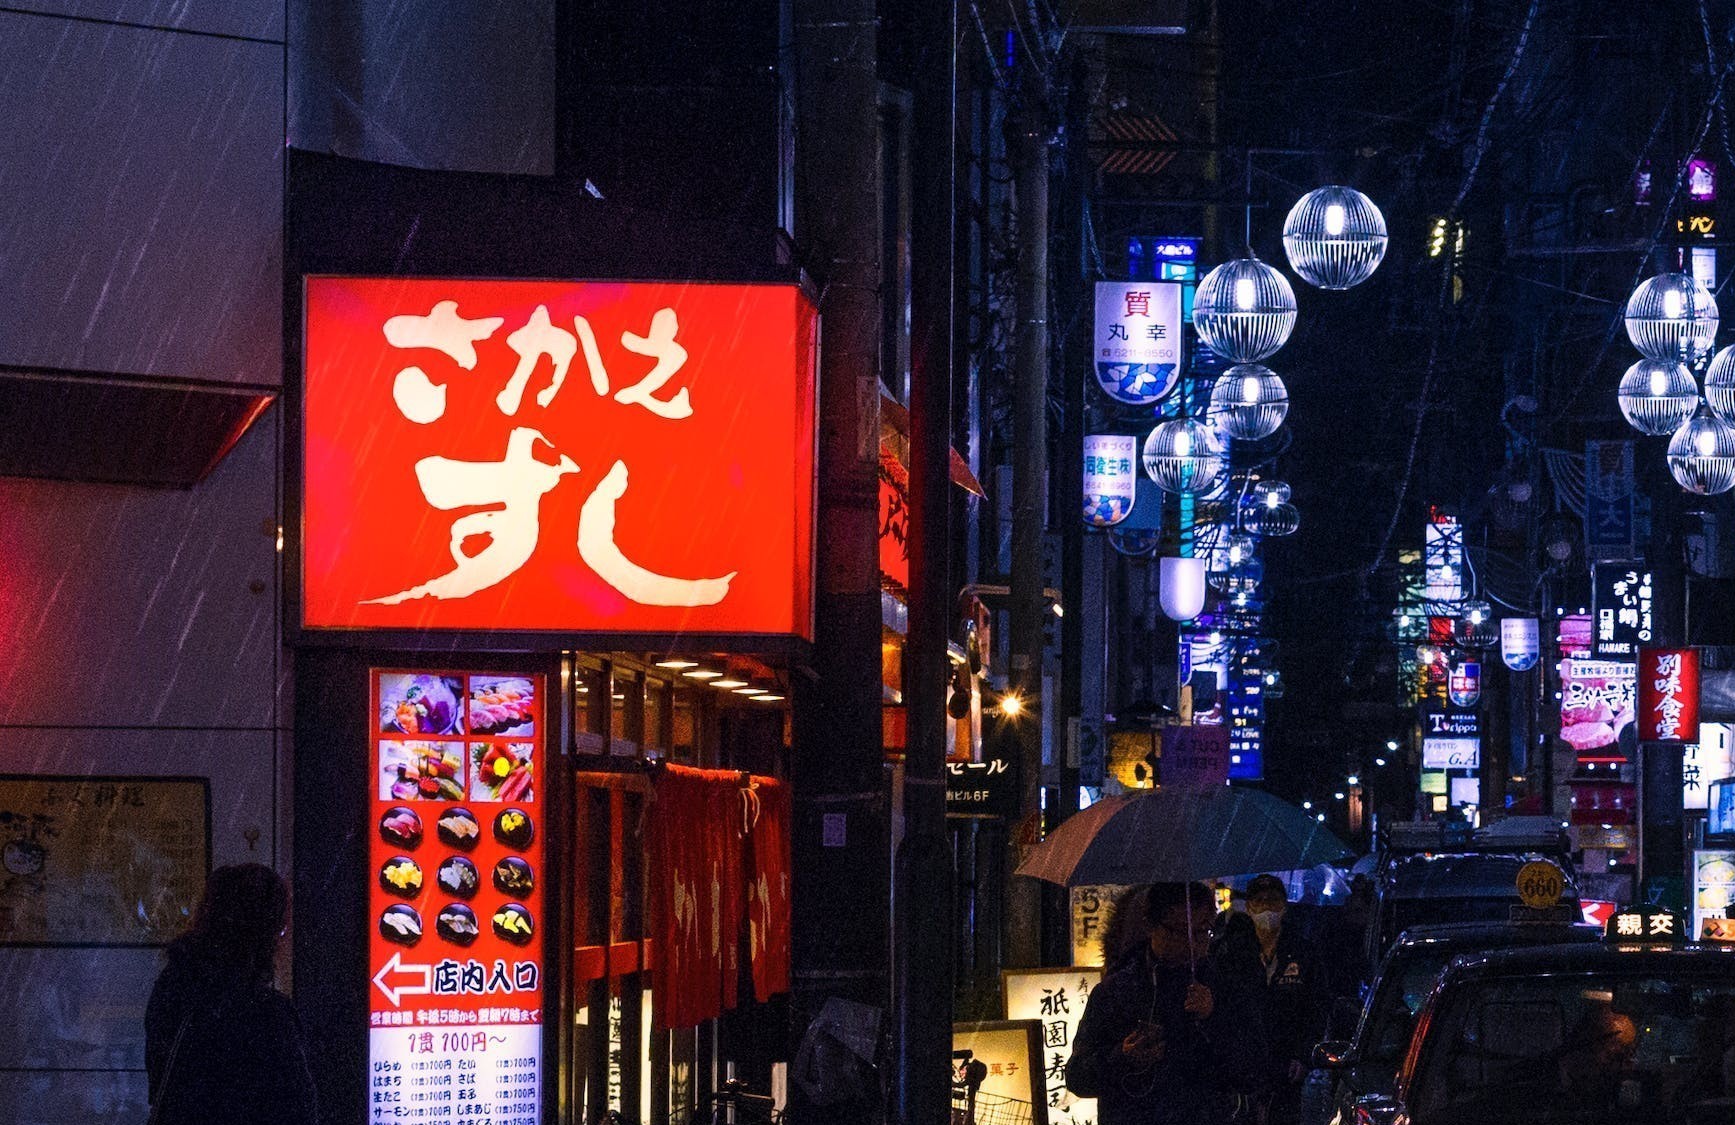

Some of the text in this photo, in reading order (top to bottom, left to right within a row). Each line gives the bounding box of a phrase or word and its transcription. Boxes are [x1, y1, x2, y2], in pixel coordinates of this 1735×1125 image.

[1124, 291, 1151, 317] 質
[382, 299, 694, 425] さかえ
[357, 426, 738, 607] すし
[1654, 653, 1685, 740] 別味食堂
[1616, 913, 1674, 936] 親交
[434, 960, 539, 993] 店内入口
[408, 1031, 435, 1054] 1貫
[373, 1060, 402, 1072] ひらめ
[458, 1059, 476, 1069] たい
[373, 1076, 402, 1087] はまち
[458, 1073, 476, 1085] さば
[373, 1106, 410, 1118] サーモン
[457, 1103, 492, 1115] しまあじ
